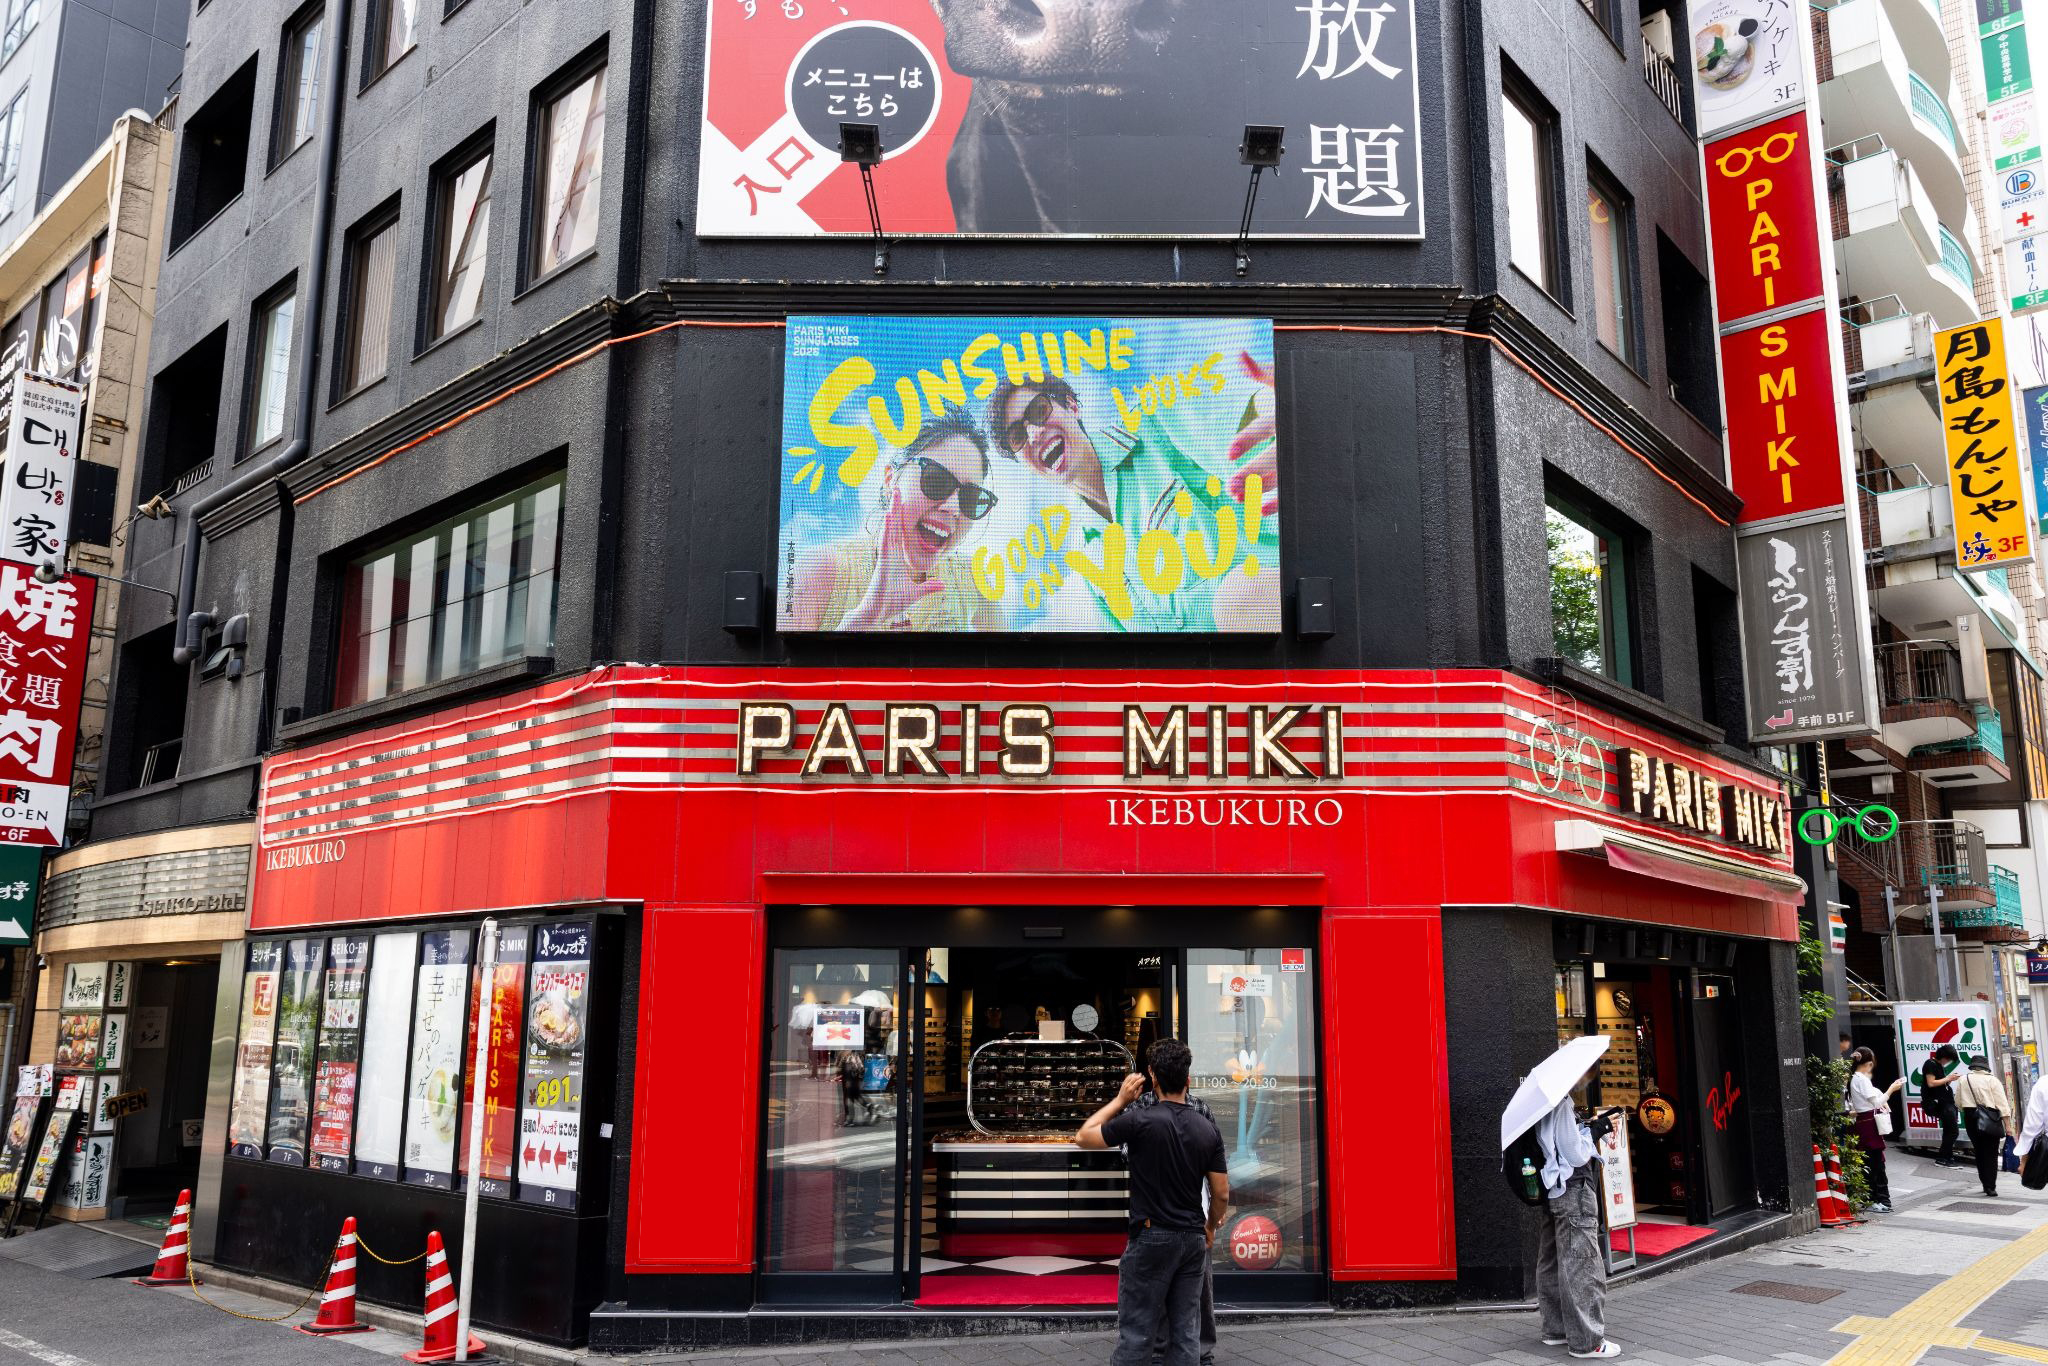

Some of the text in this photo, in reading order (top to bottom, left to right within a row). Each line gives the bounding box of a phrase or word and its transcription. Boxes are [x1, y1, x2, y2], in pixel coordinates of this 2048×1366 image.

[1992, 16, 2010, 31] 6F
[803, 67, 923, 89] メニューは
[1773, 82, 1797, 103] 3F
[2001, 82, 2019, 98] 5F
[827, 93, 899, 117] こちら
[1295, 0, 1411, 219] 放題
[2009, 151, 2028, 165] 4F
[733, 136, 815, 216] 入口
[2021, 237, 2039, 293] 献血ルーム
[2025, 290, 2046, 305] 3F
[793, 325, 849, 336] PARIS MIKI
[793, 335, 860, 347] SUNGLASSES
[1746, 178, 1800, 504] PARIS MIKI
[1112, 352, 1226, 433] LOOKS
[808, 327, 1137, 488] SUNSHINE
[973, 504, 1072, 602] GOOD
[1998, 535, 2025, 553] 3F
[1023, 562, 1066, 610] ON
[1768, 537, 1814, 694] ふらんす亭
[1798, 694, 1816, 703] 1979
[1797, 711, 1855, 728] 手前 B1F
[738, 702, 1345, 784] PARIS MIKI
[1620, 748, 1786, 853] PARIS MIKI
[1107, 798, 1344, 827] IKEBUKURO
[266, 839, 346, 871] IKEBUKURO
[331, 942, 368, 955] SEIKO-EN
[507, 938, 527, 951] MIKI
[484, 987, 505, 1178] PARIS MIKI
[108, 1092, 147, 1115] OPEN
[243, 1146, 252, 1155] 8F
[283, 1152, 292, 1161] 7F
[373, 1165, 383, 1176] 4F
[424, 1172, 434, 1183] 3F
[545, 1190, 556, 1202] B1
[1233, 1226, 1262, 1241] Come in
[1257, 1233, 1278, 1242] WE'RE
[1235, 1242, 1278, 1260] OPEN
